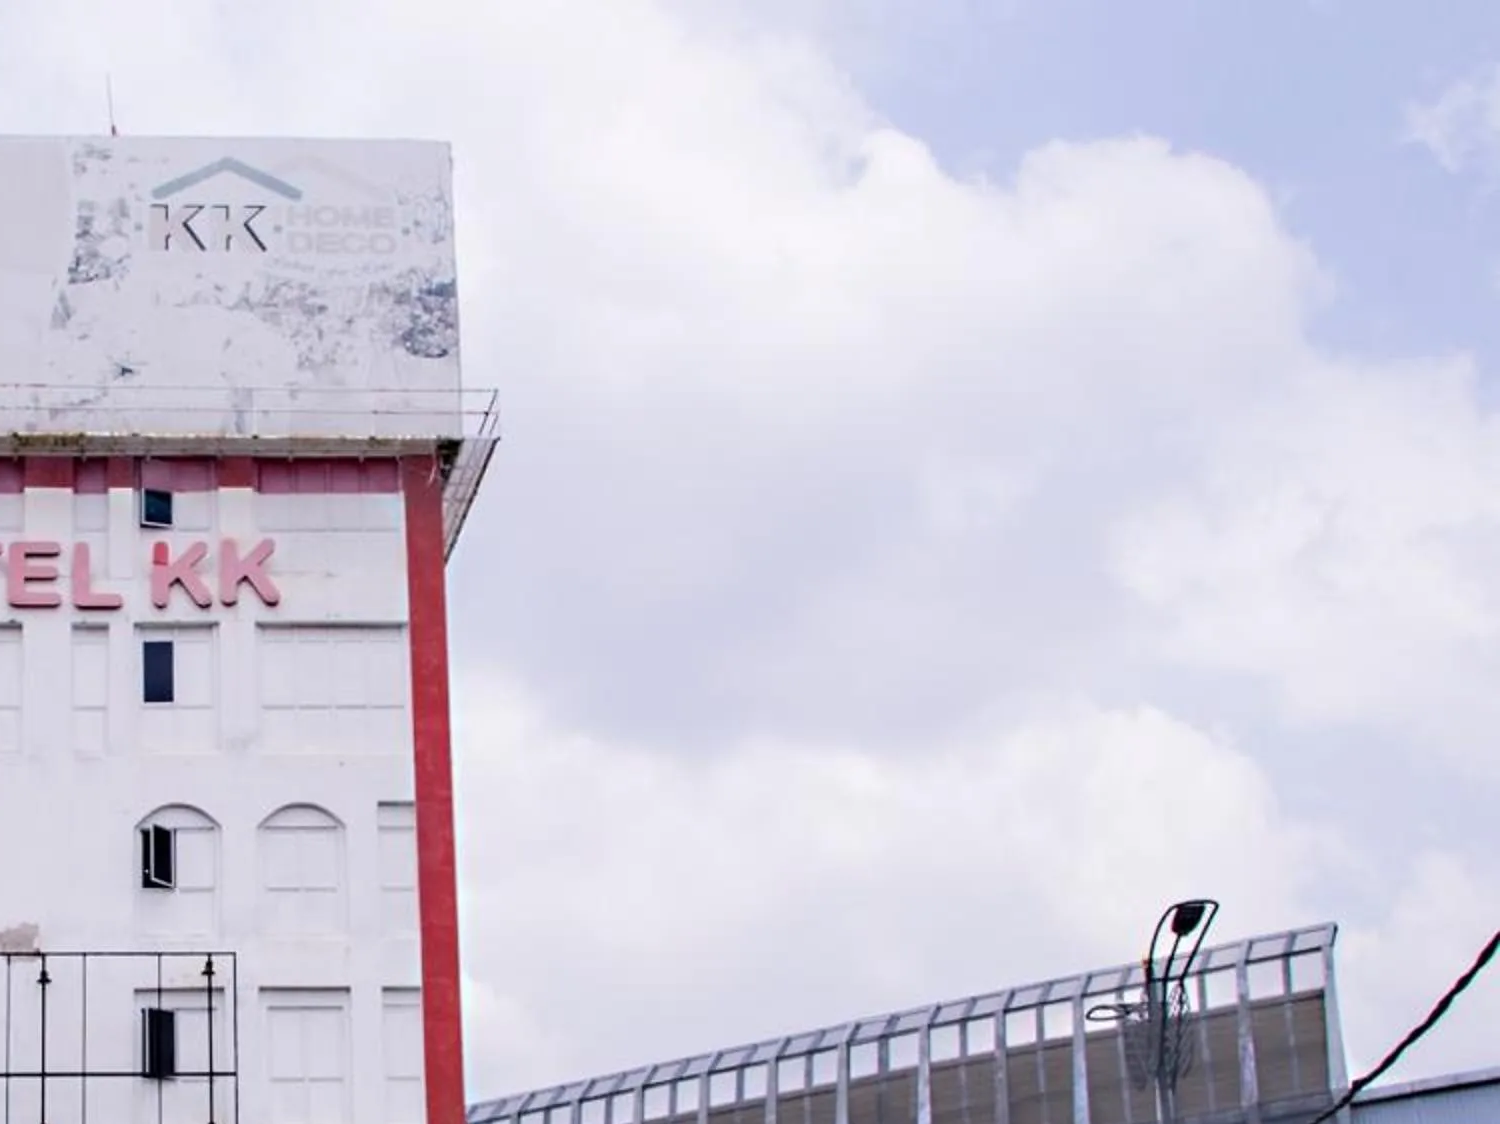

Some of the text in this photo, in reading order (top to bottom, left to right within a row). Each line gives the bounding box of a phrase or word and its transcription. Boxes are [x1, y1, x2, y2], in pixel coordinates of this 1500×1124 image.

[287, 206, 396, 228] HOME
[287, 232, 397, 252] DECO
[151, 538, 281, 609] KK
